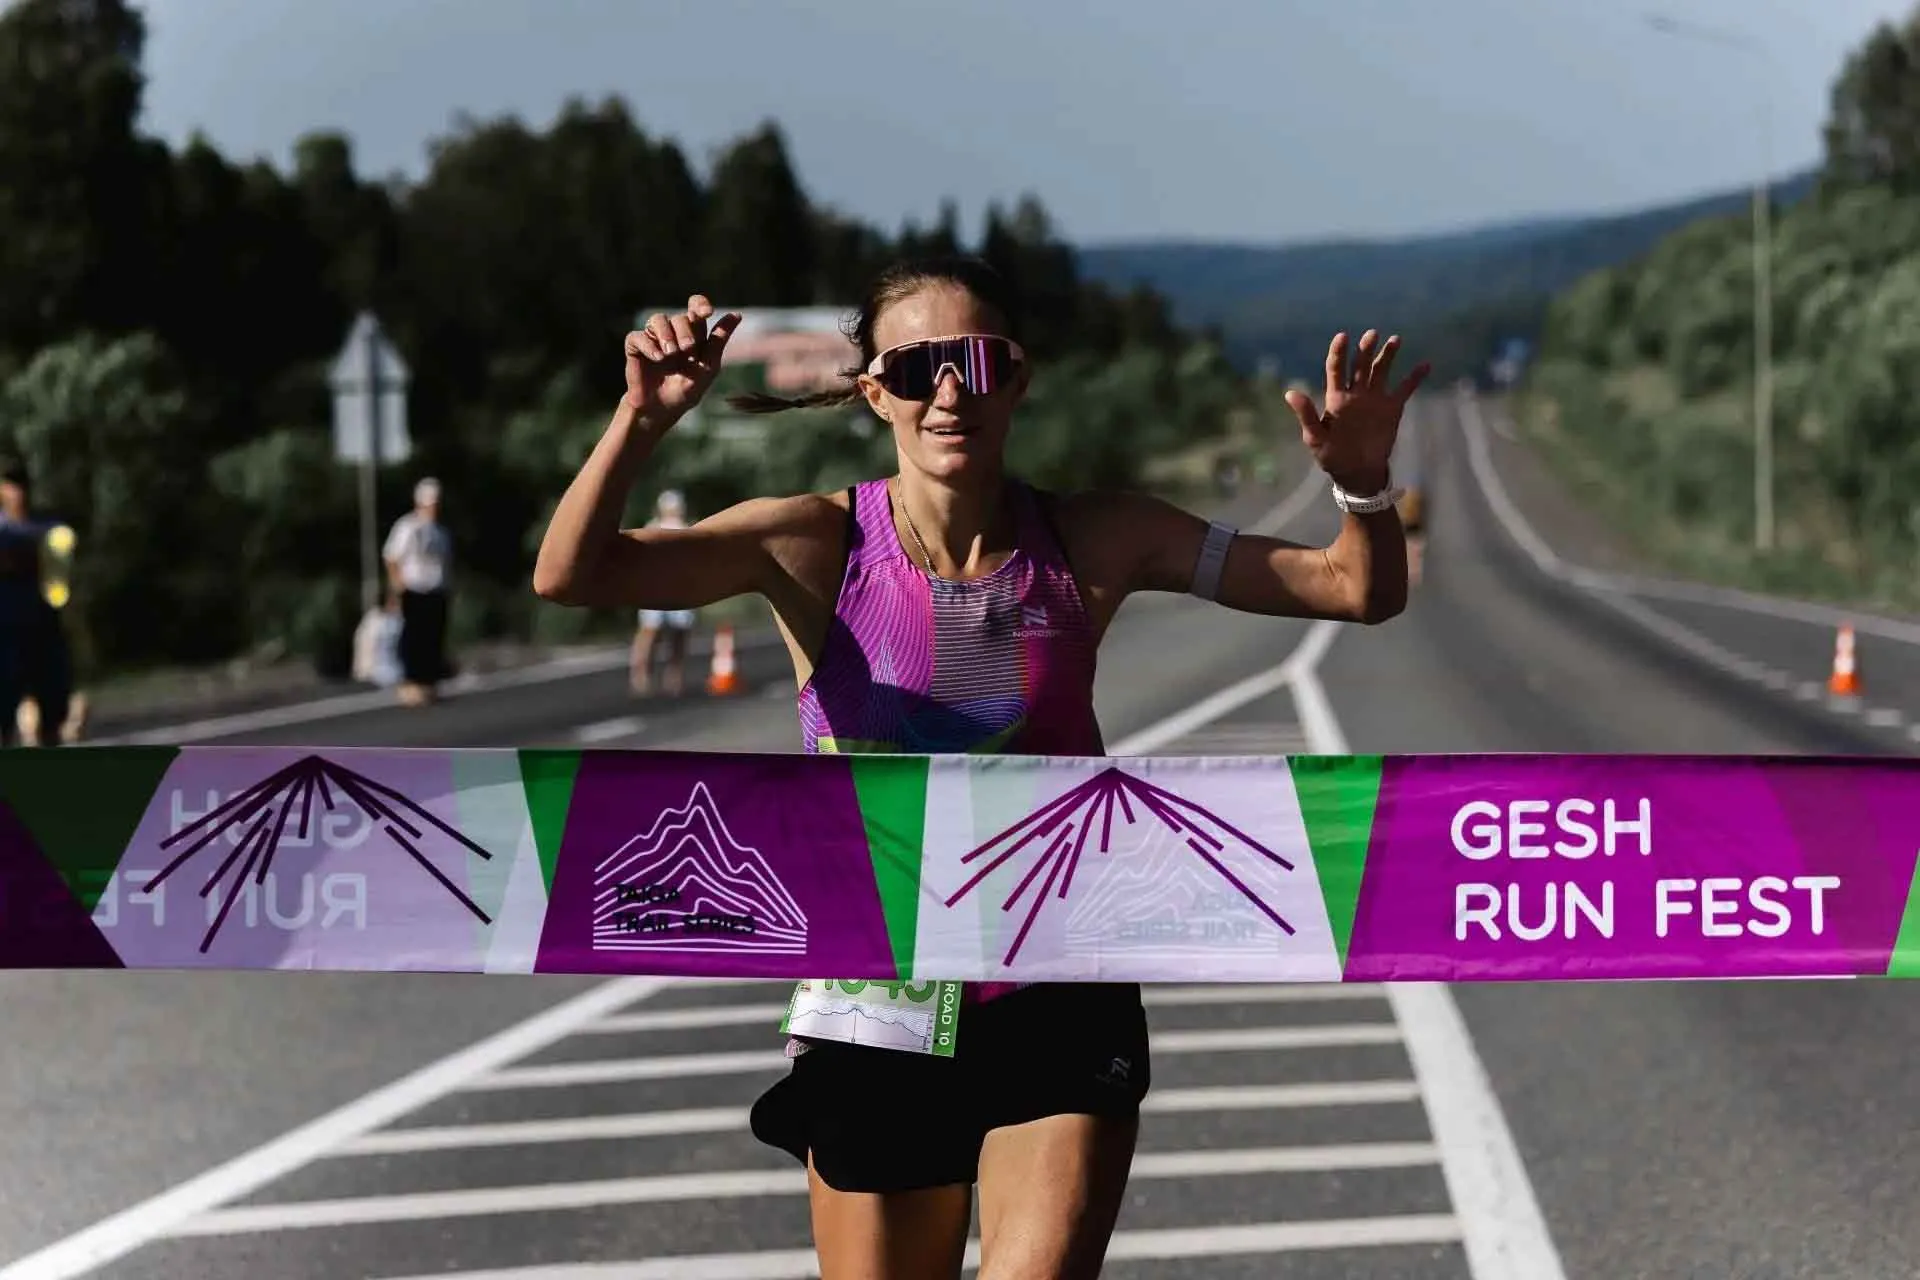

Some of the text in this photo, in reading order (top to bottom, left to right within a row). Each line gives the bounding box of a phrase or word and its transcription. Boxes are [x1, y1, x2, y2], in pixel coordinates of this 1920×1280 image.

[1450, 797, 1652, 861] GESH
[613, 911, 670, 933] TRAIL
[615, 883, 680, 904] TAIGA
[1454, 875, 1842, 942] RUN FEST
[938, 982, 956, 1047] ROAD 10
